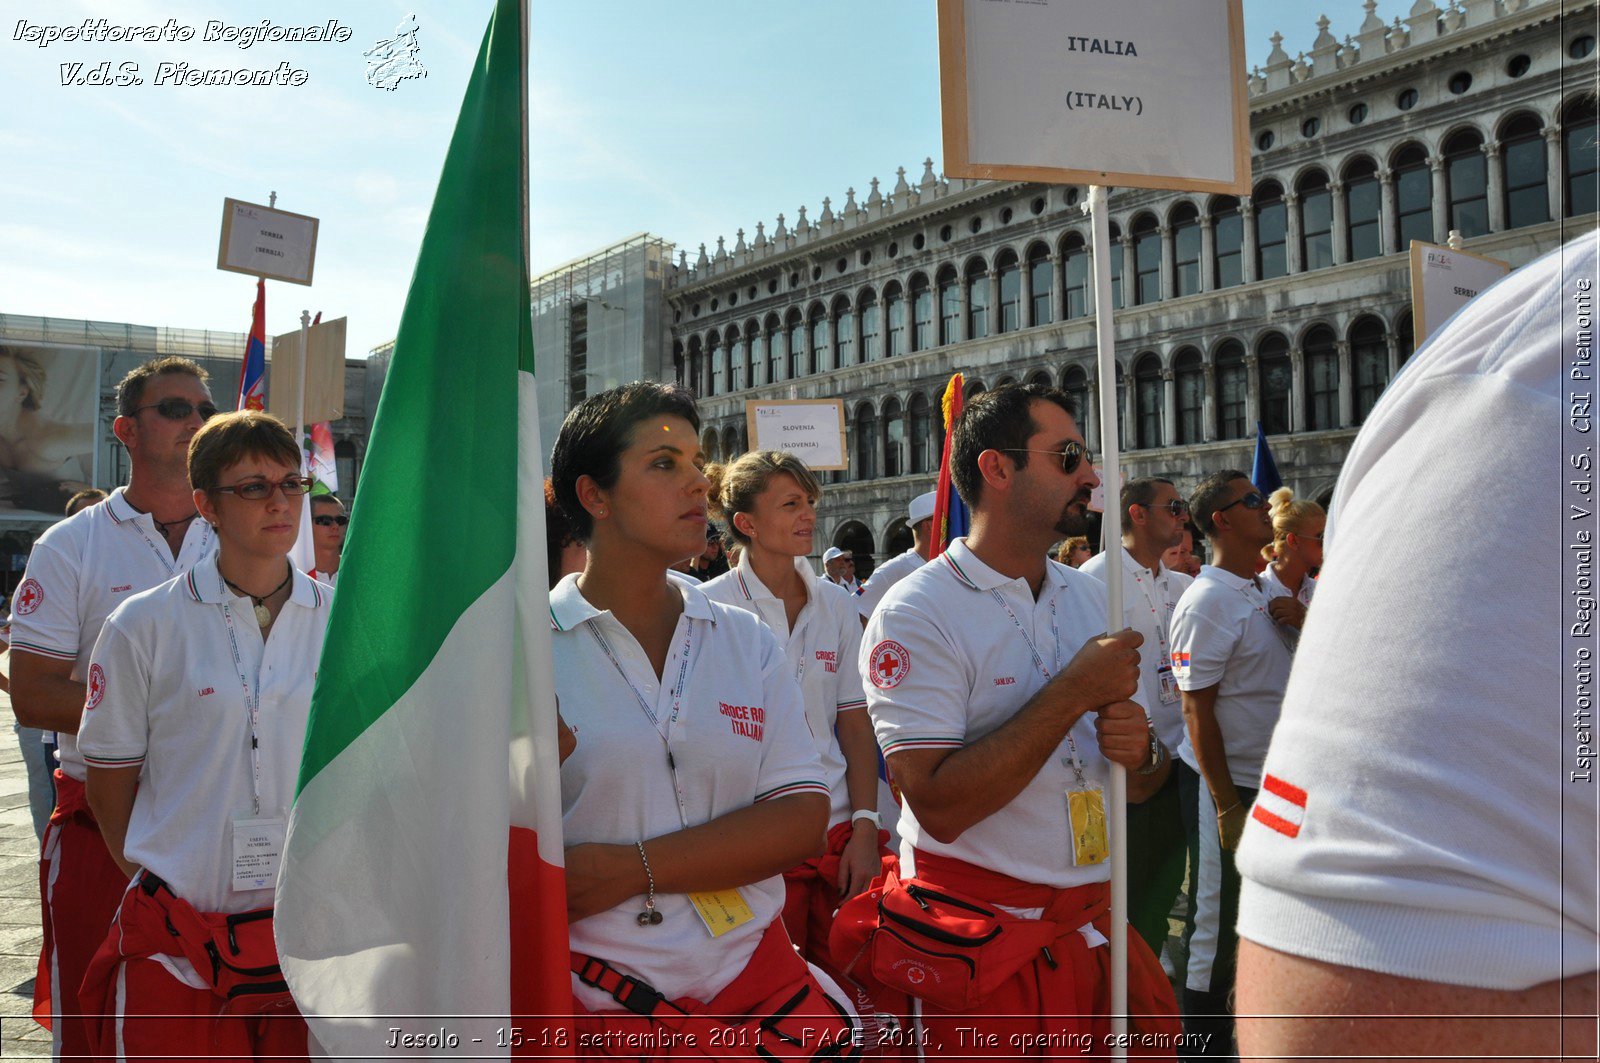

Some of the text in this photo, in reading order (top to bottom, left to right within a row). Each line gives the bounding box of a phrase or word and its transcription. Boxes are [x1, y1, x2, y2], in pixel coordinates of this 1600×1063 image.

[1068, 36, 1138, 57] ITALIA
[1065, 90, 1143, 115] (ITALY)
[260, 230, 284, 240] SERBIA
[255, 246, 285, 258] (SERBIA)
[815, 650, 836, 661] CROCE
[824, 661, 837, 673] ITAL
[197, 686, 215, 697] LAURA
[719, 701, 765, 724] CROCE RO
[731, 718, 763, 743] ITALIAN
